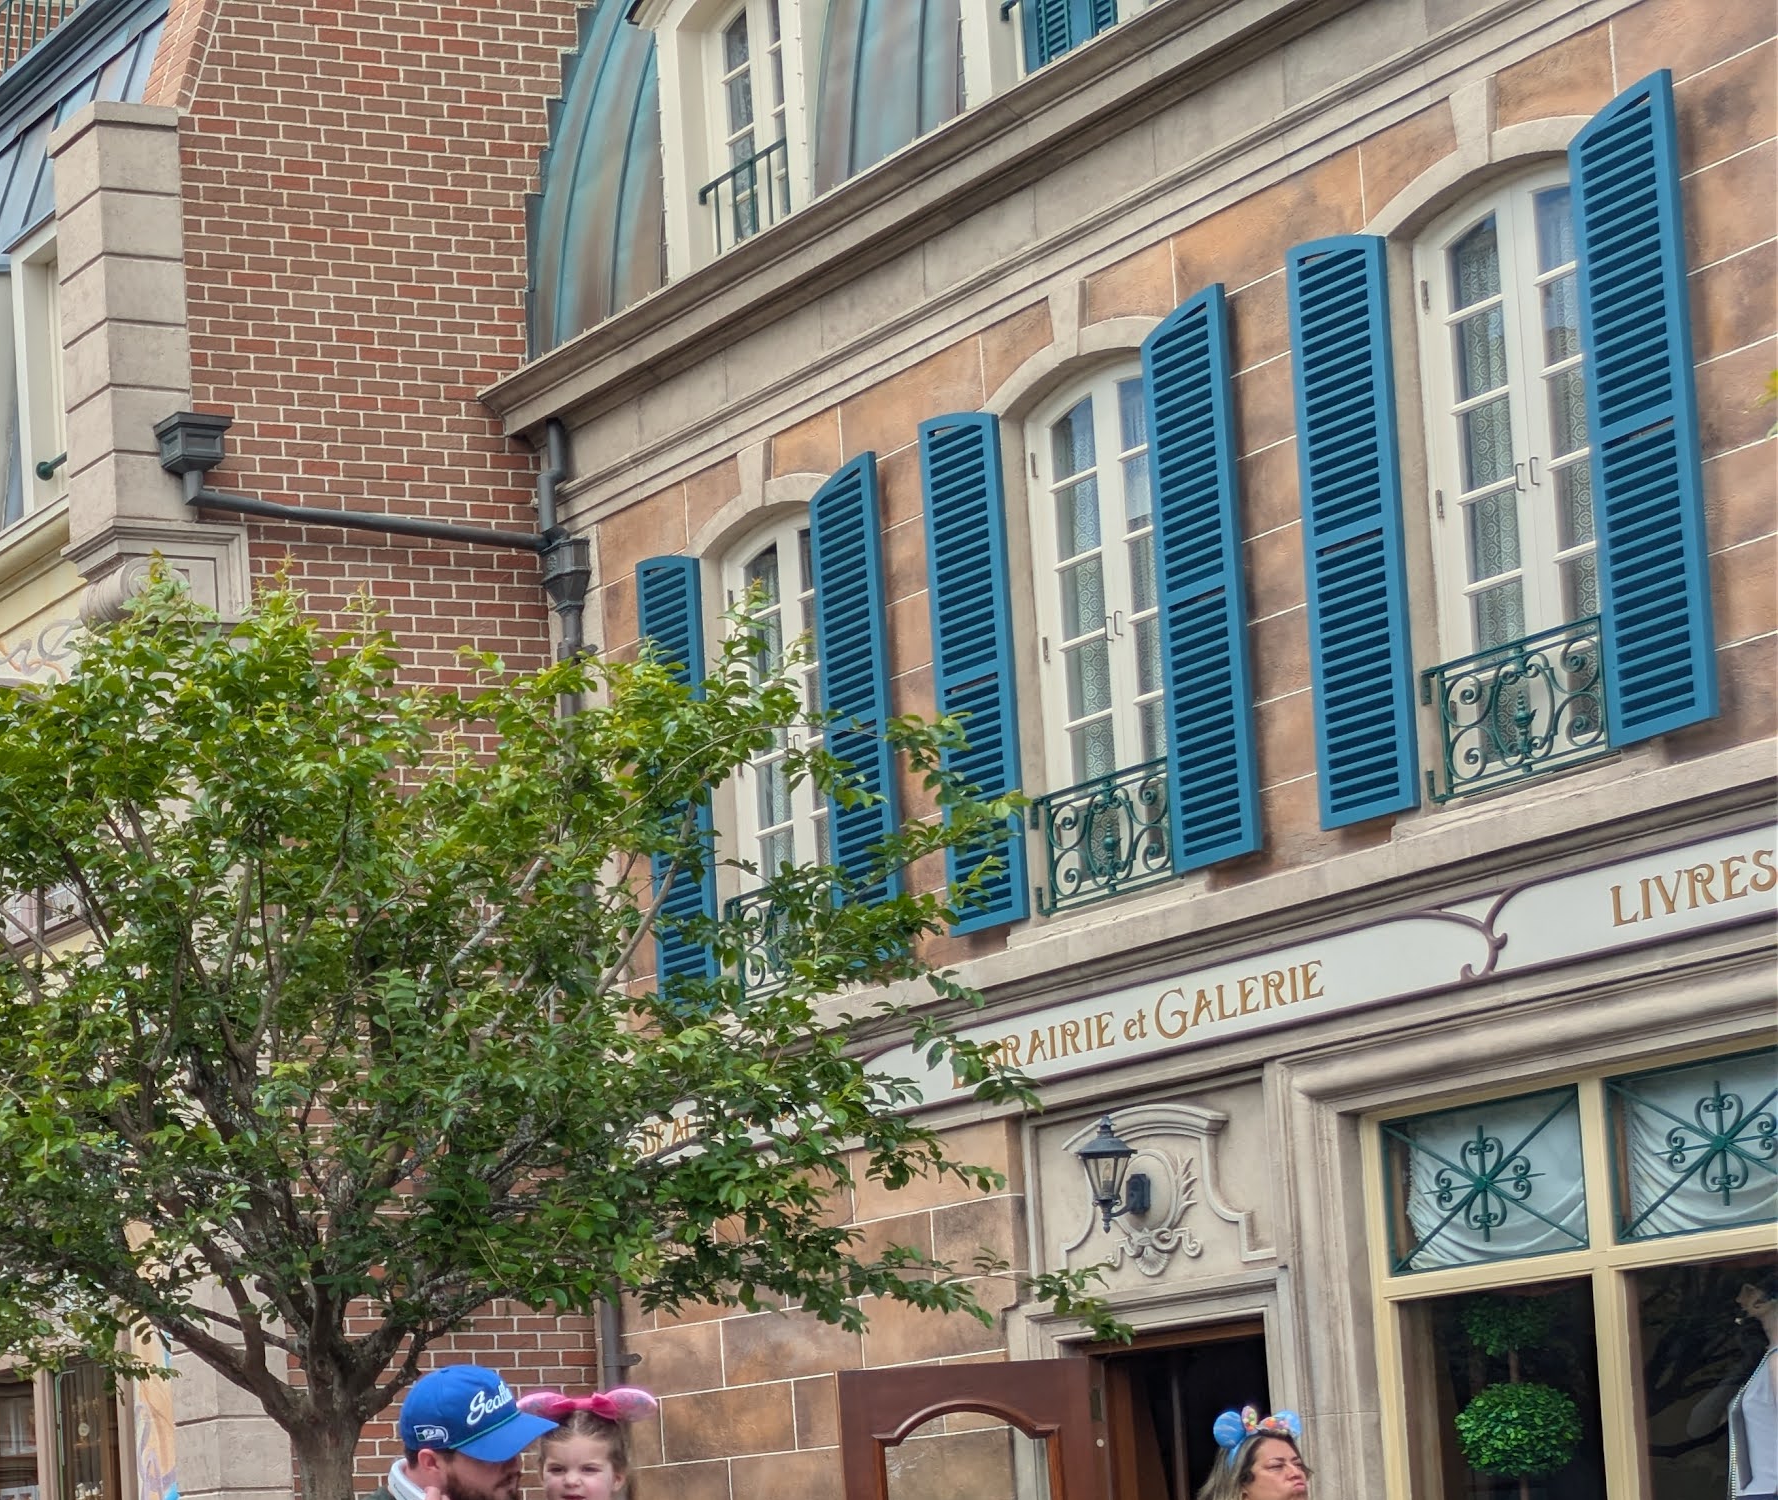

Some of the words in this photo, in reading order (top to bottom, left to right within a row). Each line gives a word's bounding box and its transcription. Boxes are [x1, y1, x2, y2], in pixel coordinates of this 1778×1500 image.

[1610, 850, 1778, 927] LIVRES
[952, 1011, 1115, 1089] BRAIRIE
[1122, 1008, 1148, 1042] et
[1154, 959, 1325, 1040] GALERIE
[466, 1380, 513, 1426] Seatt
